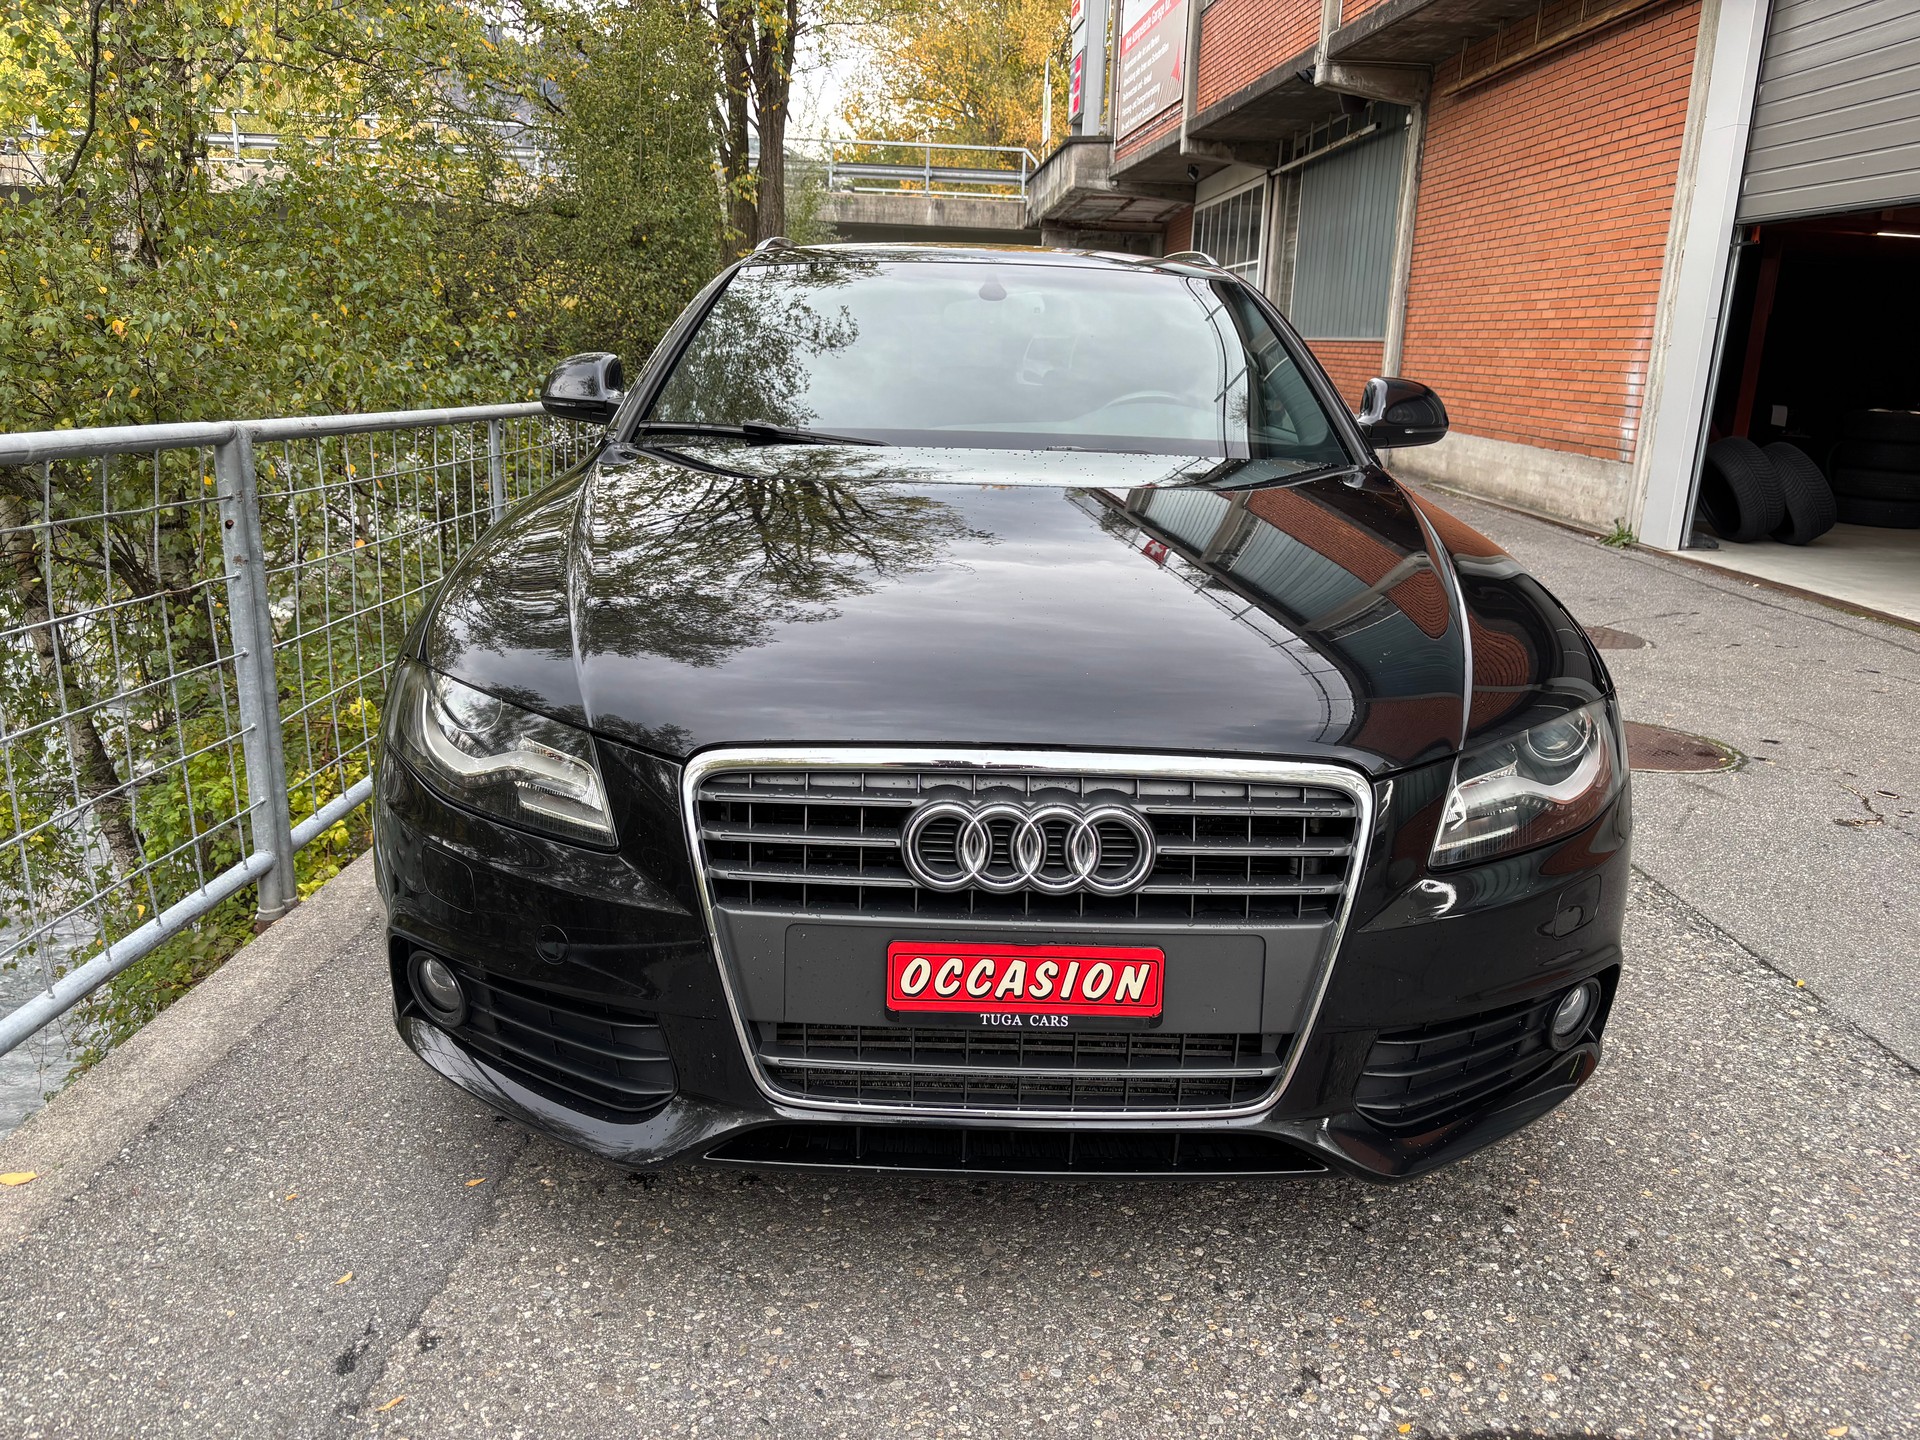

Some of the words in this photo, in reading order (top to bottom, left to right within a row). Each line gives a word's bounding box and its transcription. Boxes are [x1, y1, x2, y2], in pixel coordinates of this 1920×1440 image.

[899, 956, 1151, 1004] OCCASION
[980, 1013, 1022, 1027] TUGA
[1029, 1015, 1070, 1028] CARS
